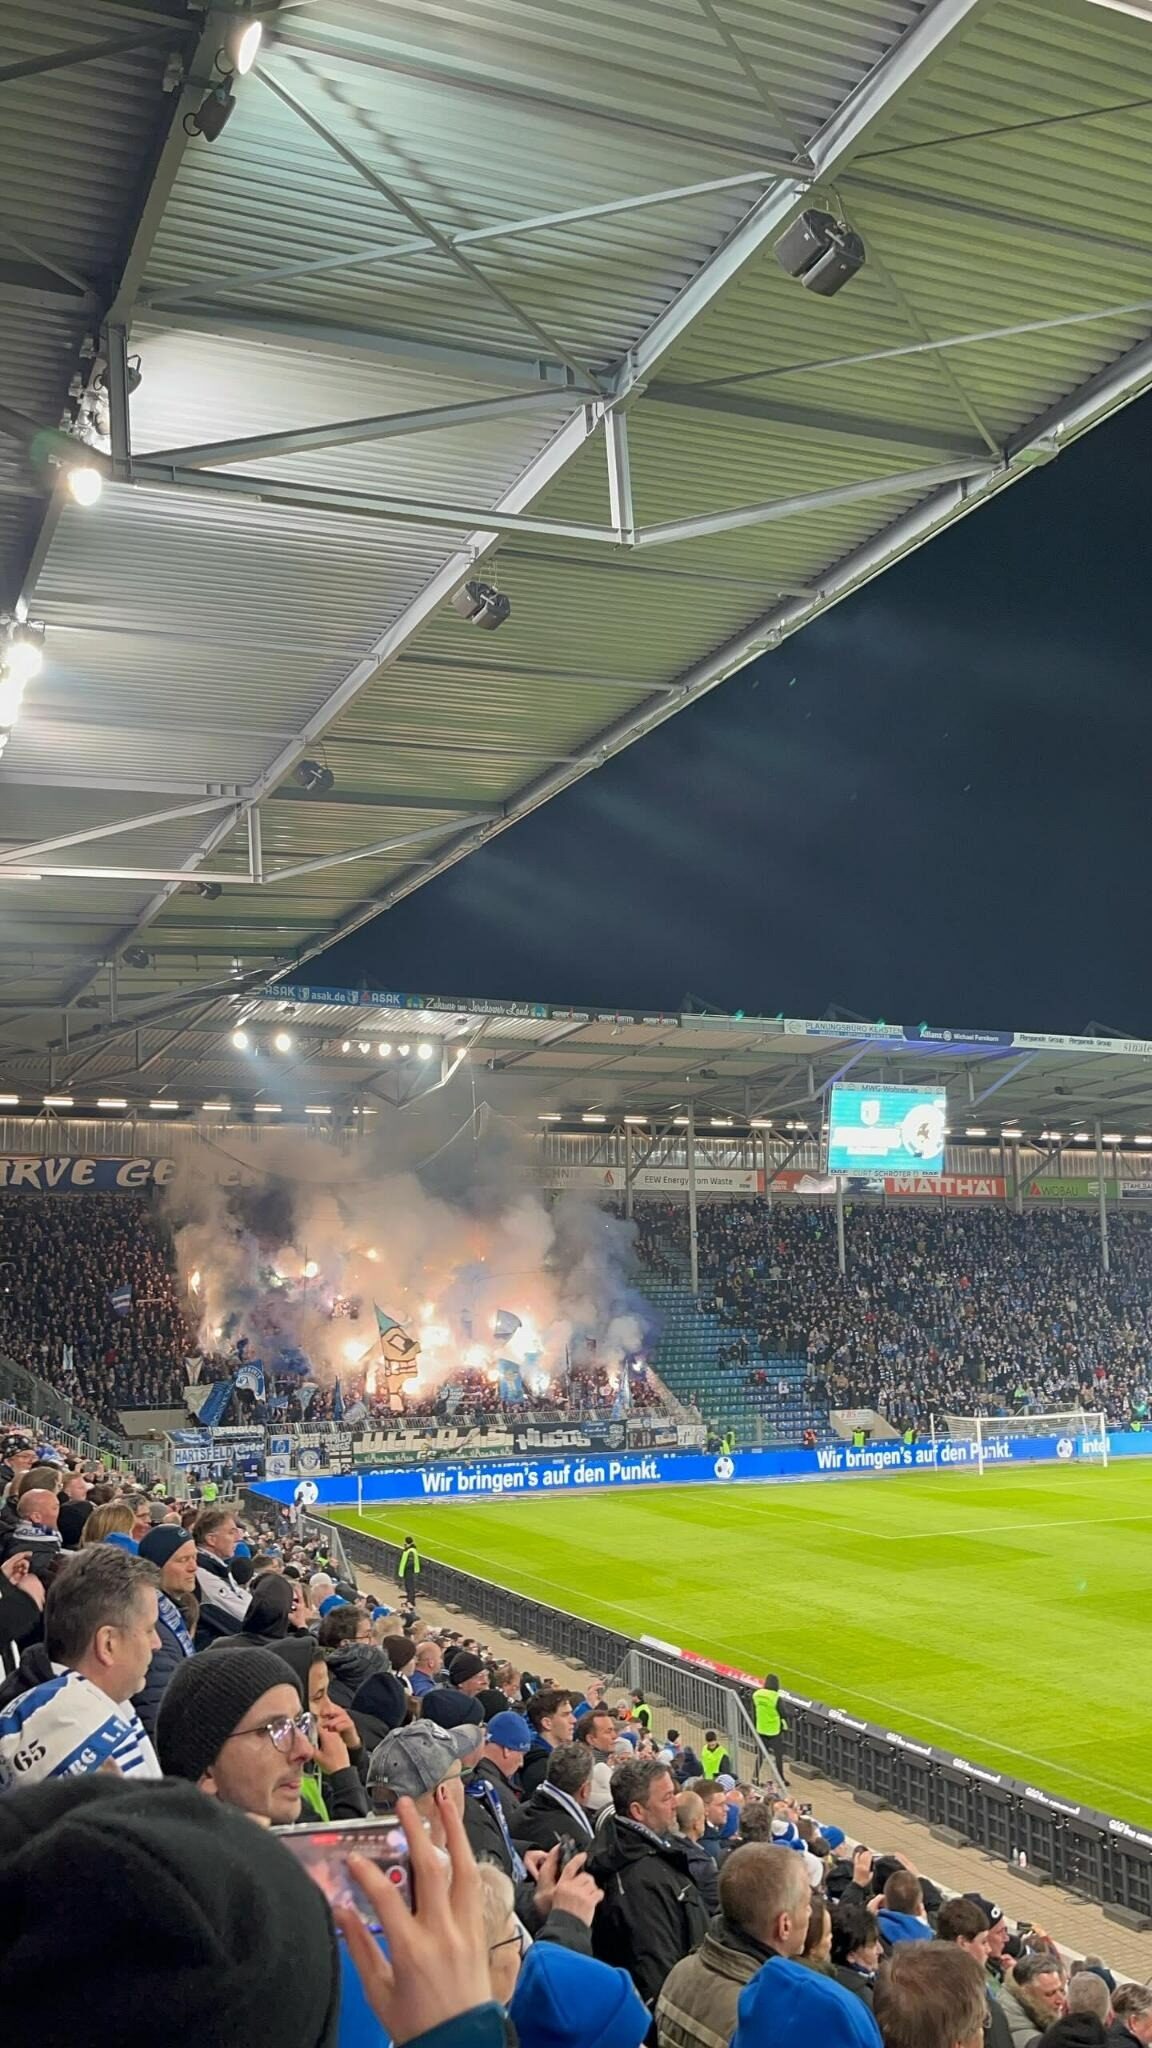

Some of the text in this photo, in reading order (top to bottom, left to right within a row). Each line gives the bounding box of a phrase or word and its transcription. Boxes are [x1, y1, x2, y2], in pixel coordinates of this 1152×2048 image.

[265, 985, 295, 997] ASAK
[311, 992, 345, 1001] asak.de
[371, 993, 400, 1004] ASAK
[920, 1030, 943, 1039] Allianz
[664, 1176, 688, 1185] Energy
[894, 1178, 997, 1195] MATTHÄI
[1083, 1437, 1111, 1454] intel
[176, 1447, 233, 1462] HARTSFELD
[817, 1451, 841, 1469] Wir
[916, 1444, 937, 1463] auf
[941, 1443, 967, 1461] den
[971, 1441, 1012, 1460] Punkt.
[422, 1472, 453, 1492] Wir
[543, 1465, 570, 1485] auf
[574, 1464, 605, 1483] den
[609, 1461, 661, 1481] Punkt.
[13, 1739, 46, 1771] 65
